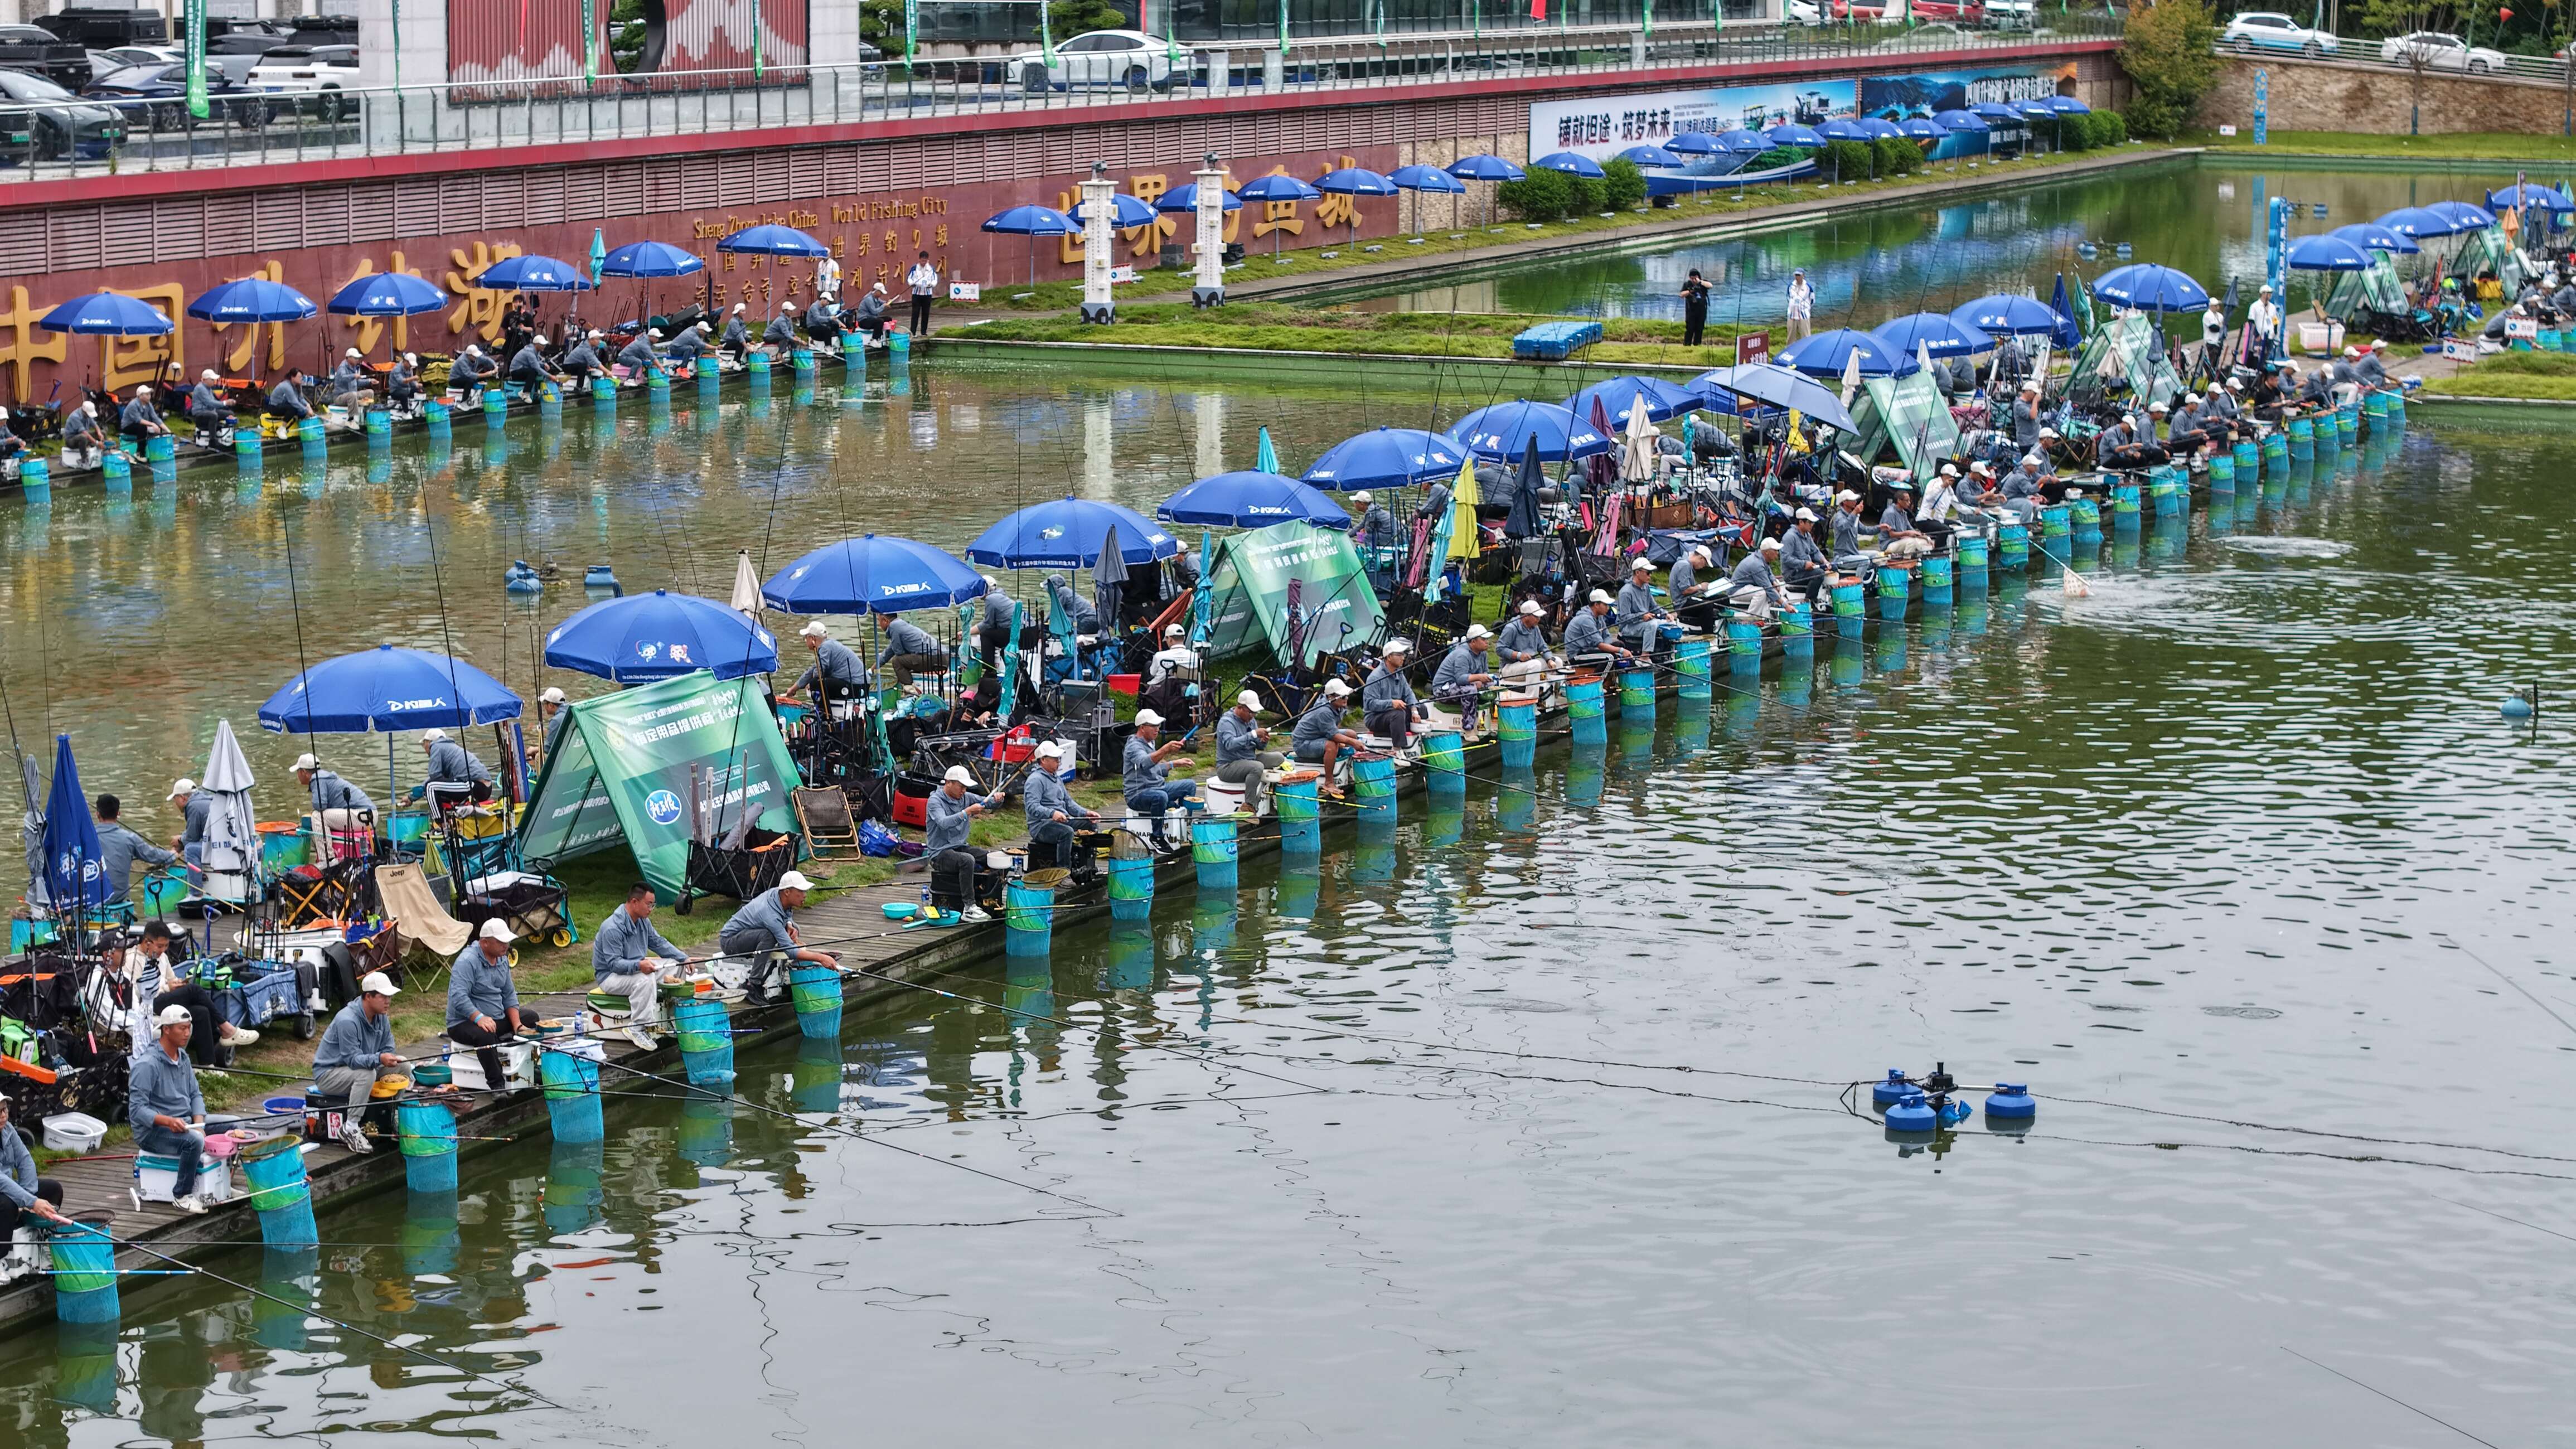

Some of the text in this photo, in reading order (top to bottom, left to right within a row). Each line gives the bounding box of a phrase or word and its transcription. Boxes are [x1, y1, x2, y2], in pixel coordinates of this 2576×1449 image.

[694, 218, 725, 240] Sheng
[788, 210, 819, 229] China
[831, 203, 866, 224] World
[870, 200, 918, 220] Fishing
[922, 196, 948, 215] City
[390, 869, 405, 878] Jeep
